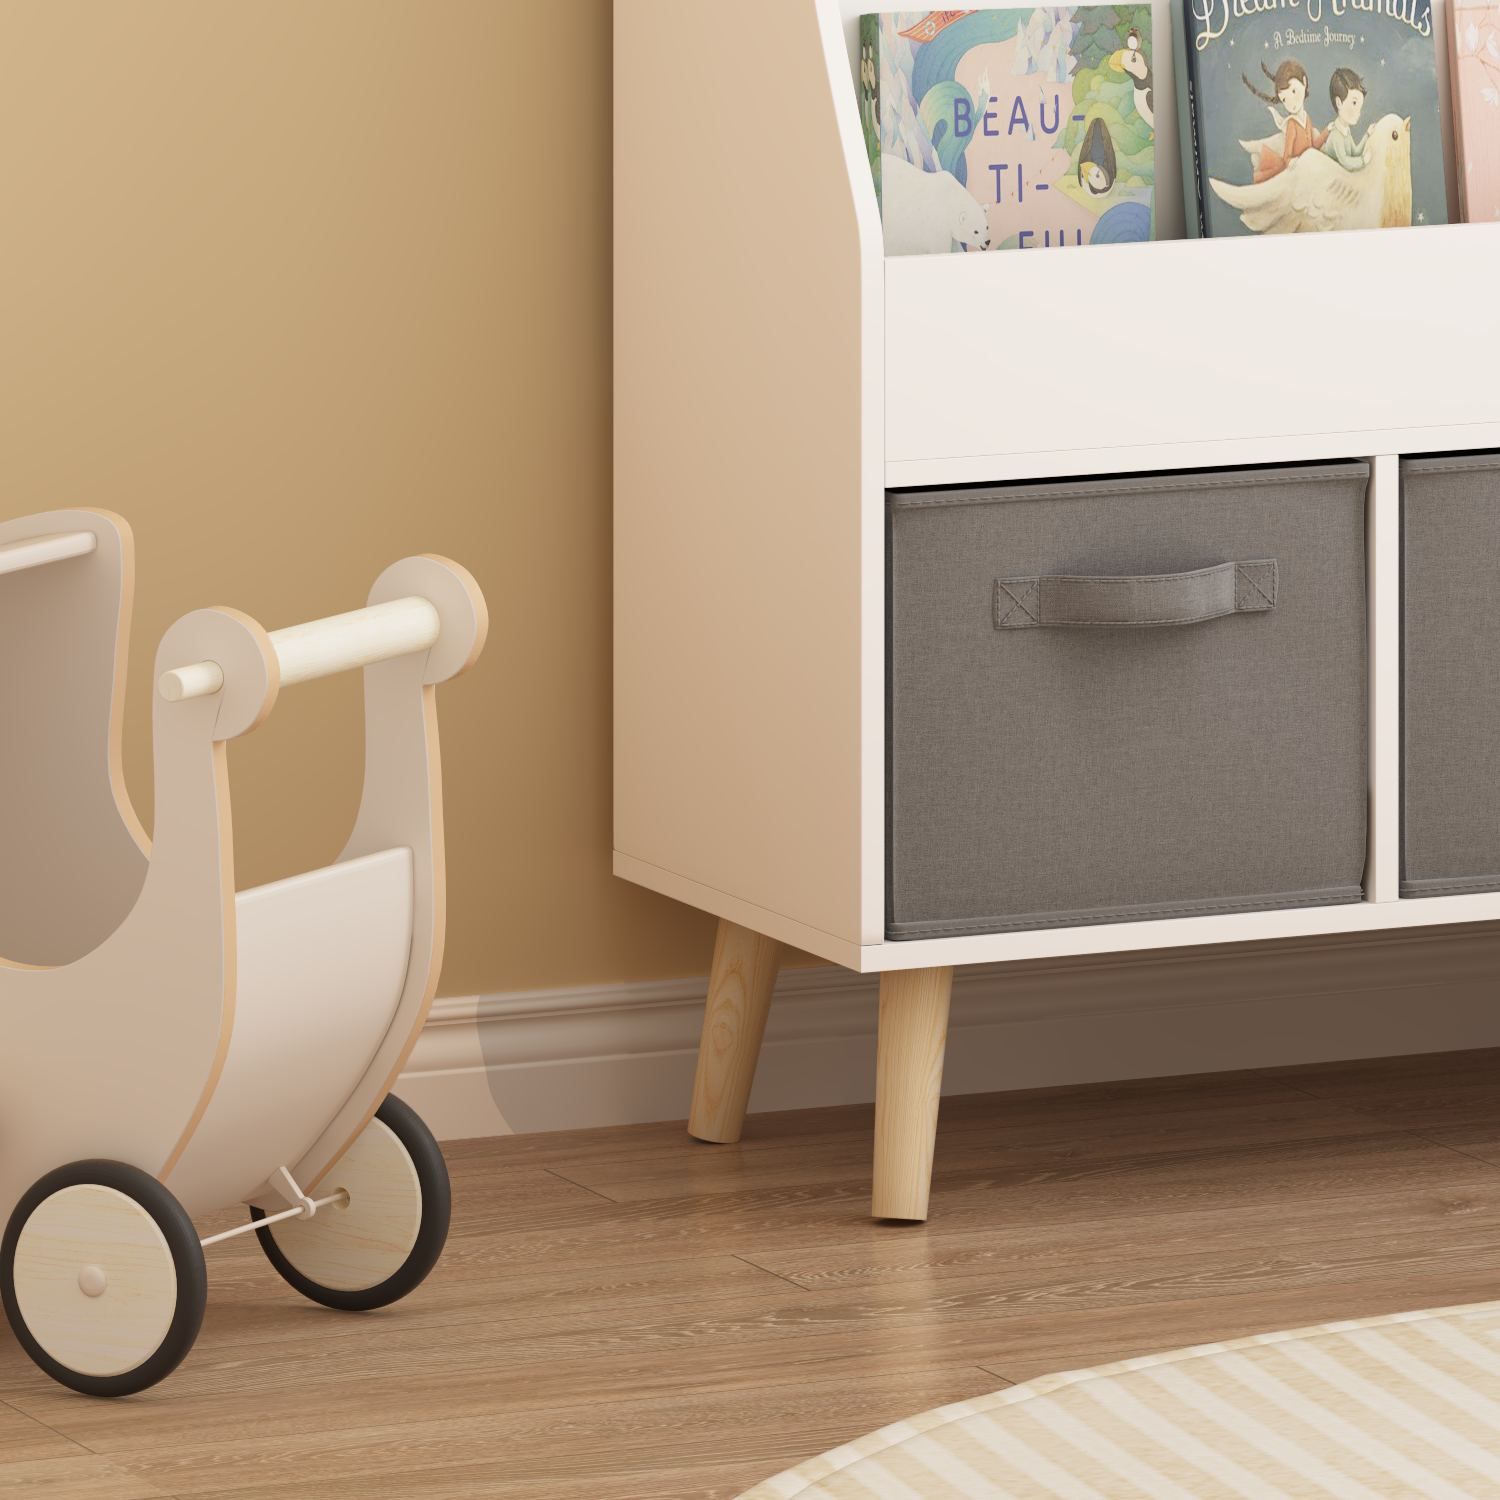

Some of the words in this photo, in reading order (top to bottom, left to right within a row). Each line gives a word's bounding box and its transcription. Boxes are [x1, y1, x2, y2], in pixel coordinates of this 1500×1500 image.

[1273, 31, 1284, 50] A
[1286, 28, 1321, 46] Bedtime
[1323, 26, 1356, 50] Journey
[954, 94, 1085, 138] BEAU-
[988, 163, 1049, 204] TI-
